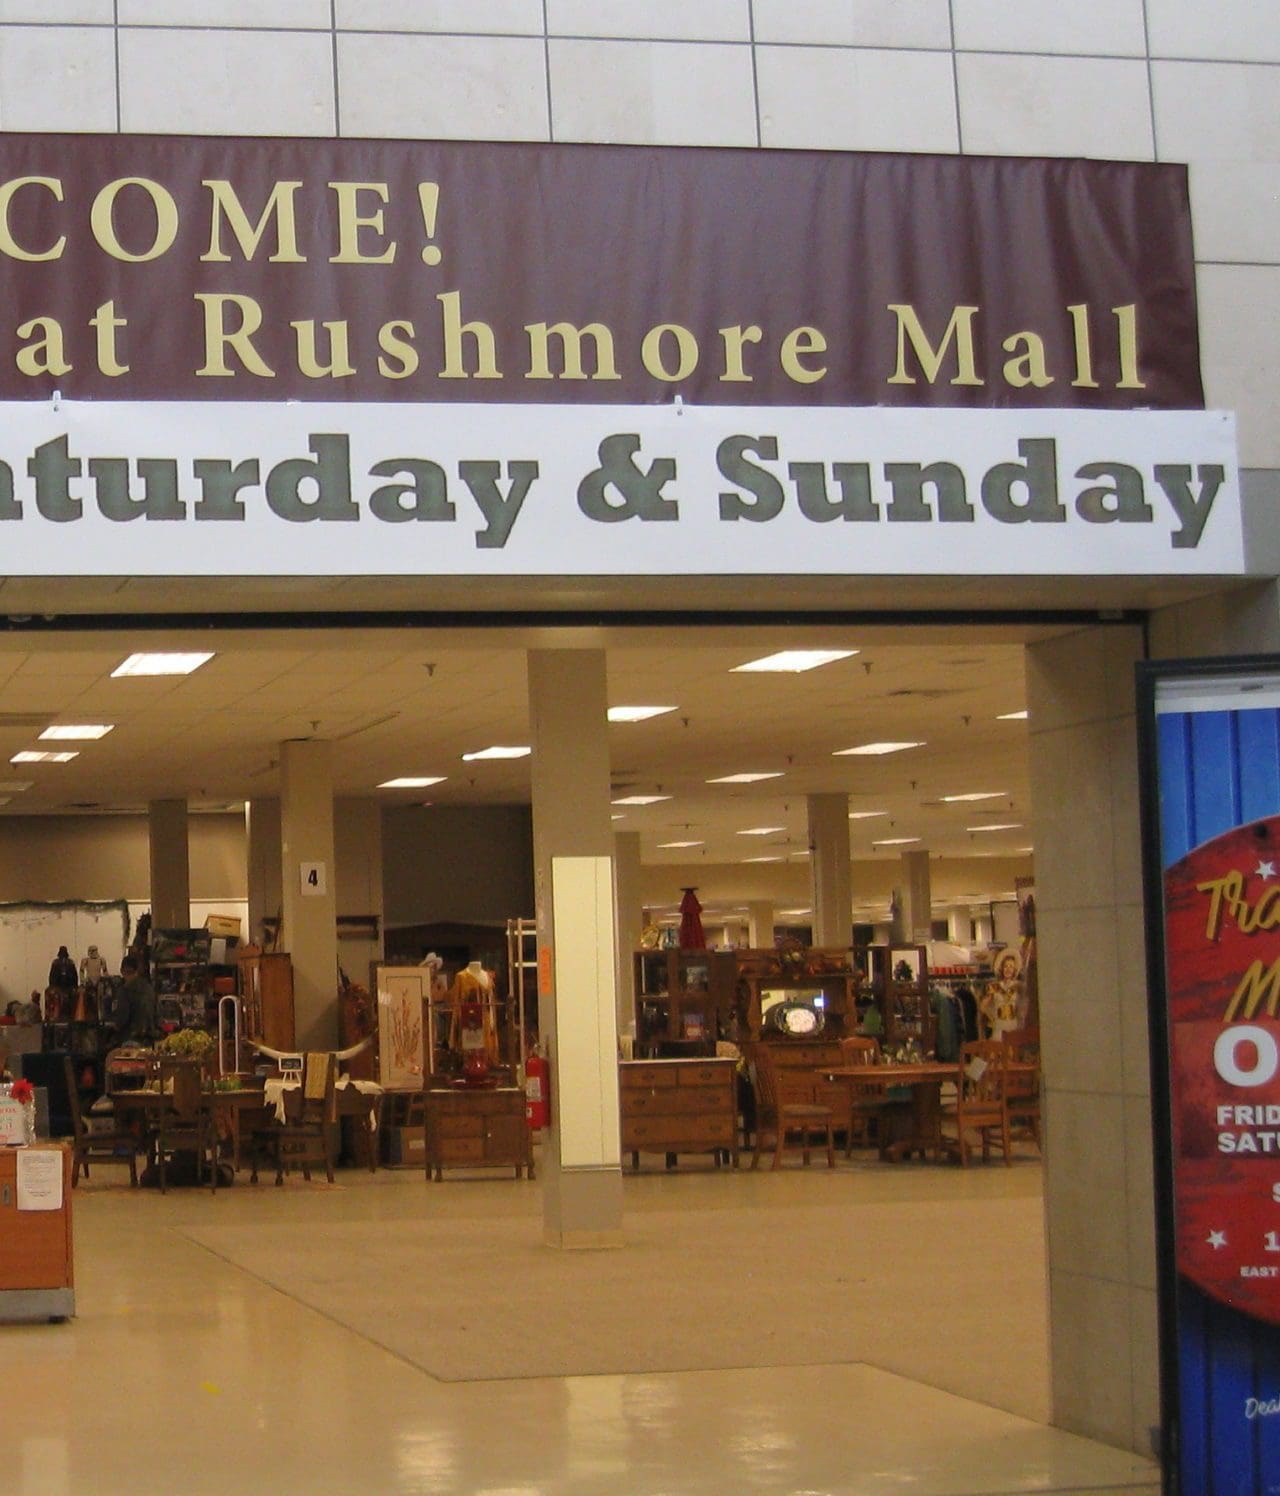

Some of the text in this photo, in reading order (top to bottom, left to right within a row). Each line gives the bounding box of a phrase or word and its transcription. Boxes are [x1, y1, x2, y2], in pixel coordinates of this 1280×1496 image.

[15, 299, 130, 377] at
[193, 289, 828, 384] Rushmore
[887, 303, 1146, 388] Mall
[577, 433, 680, 523] &
[716, 434, 1227, 549] Sunday
[308, 869, 318, 886] 4
[1214, 1025, 1279, 1087] O
[1240, 1265, 1278, 1277] EAST
